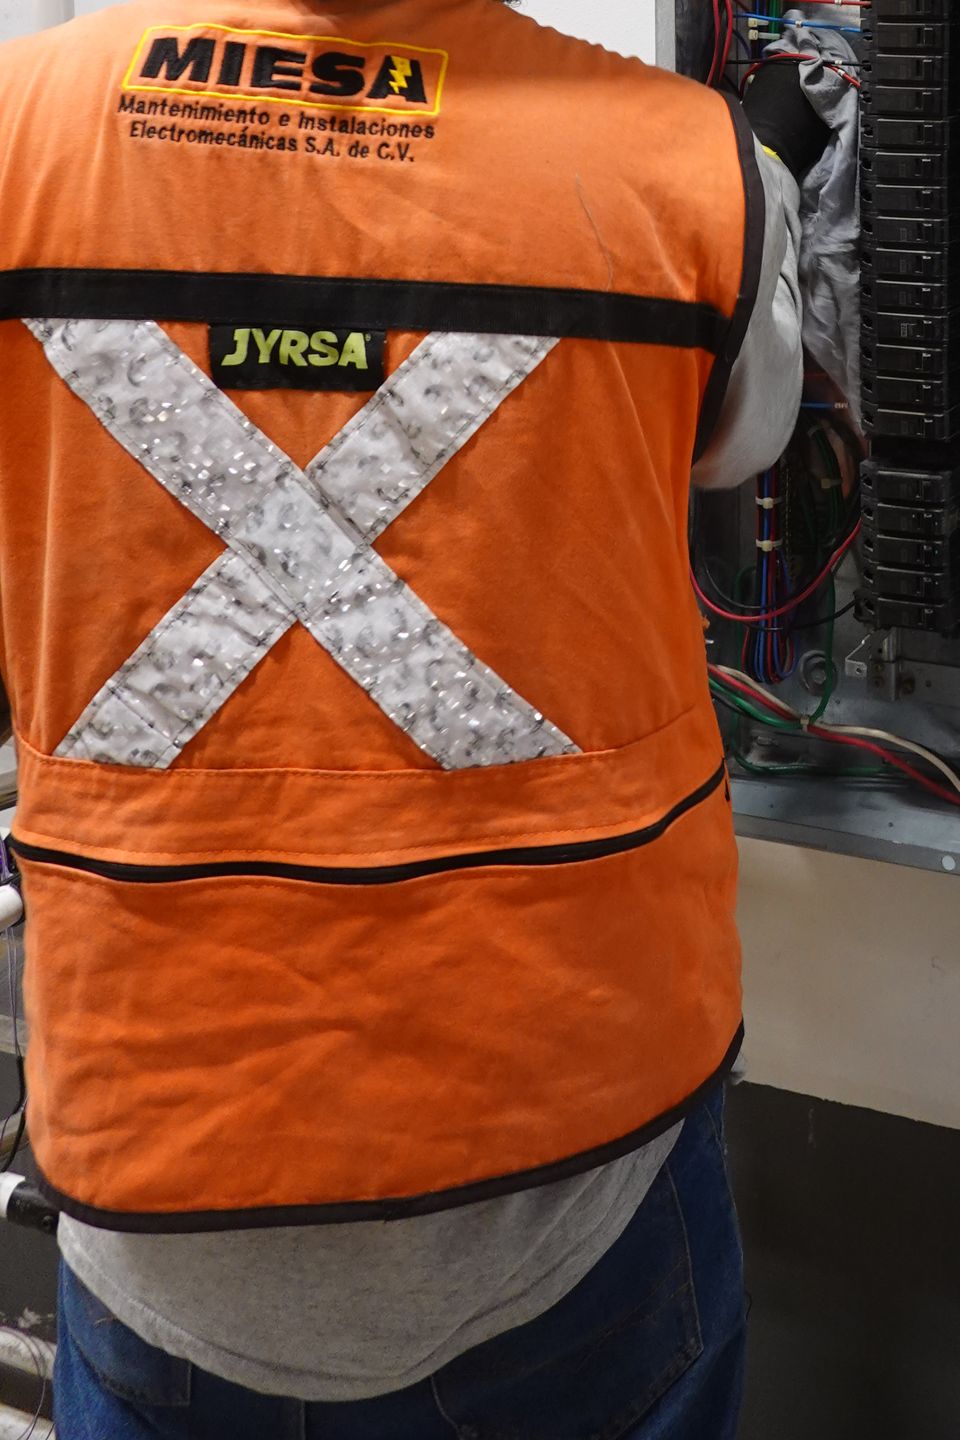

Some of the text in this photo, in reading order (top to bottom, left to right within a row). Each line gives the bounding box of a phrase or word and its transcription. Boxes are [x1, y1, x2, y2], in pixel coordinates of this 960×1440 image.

[139, 36, 427, 104] MIESA
[118, 94, 435, 139] Mantenimiento e Instalaciones
[129, 120, 414, 162] Electromecánicas S.A. de C.V.
[221, 328, 368, 369] JYRSA
